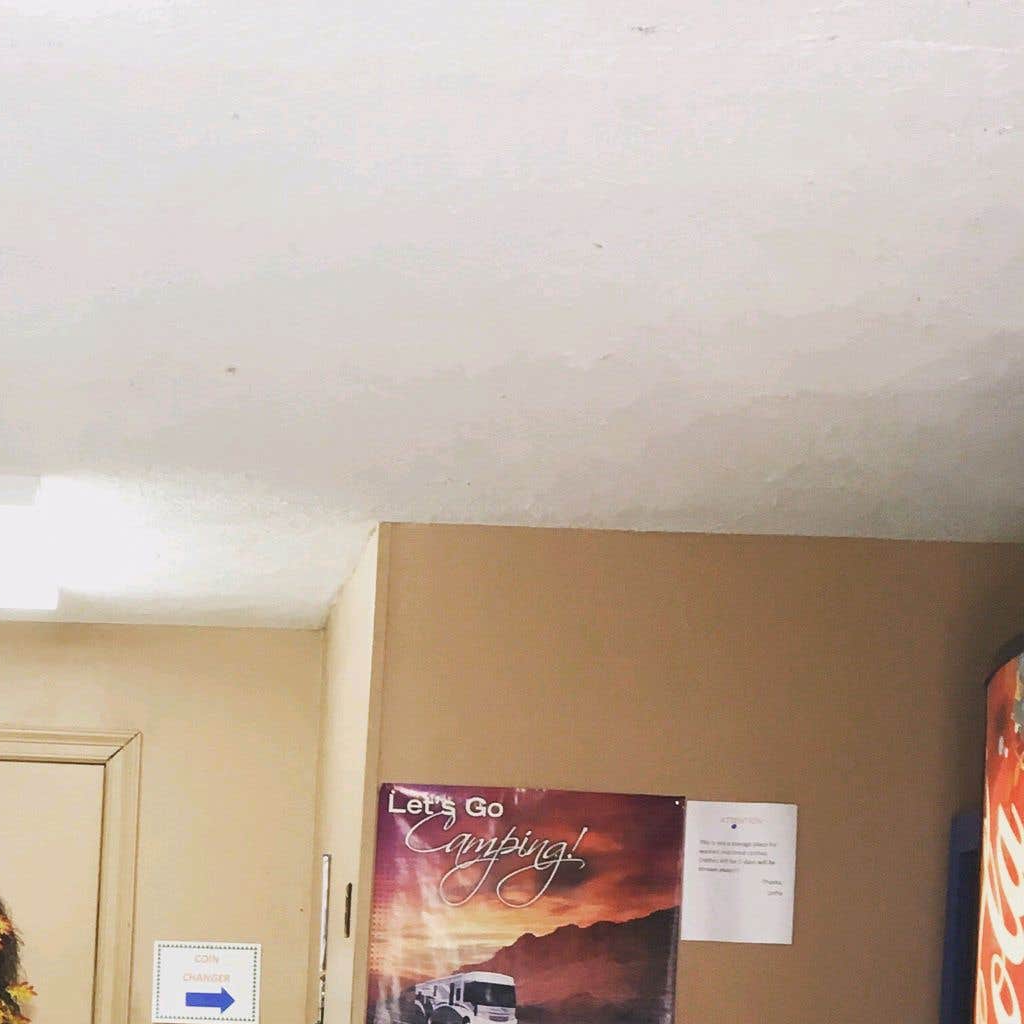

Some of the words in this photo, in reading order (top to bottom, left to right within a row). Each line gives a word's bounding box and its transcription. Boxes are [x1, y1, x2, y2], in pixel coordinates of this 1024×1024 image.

[388, 791, 456, 816] Let's
[465, 797, 504, 818] Go
[405, 811, 588, 909] Camping!
[194, 954, 220, 964] COIN
[183, 972, 231, 984] CHANGER
